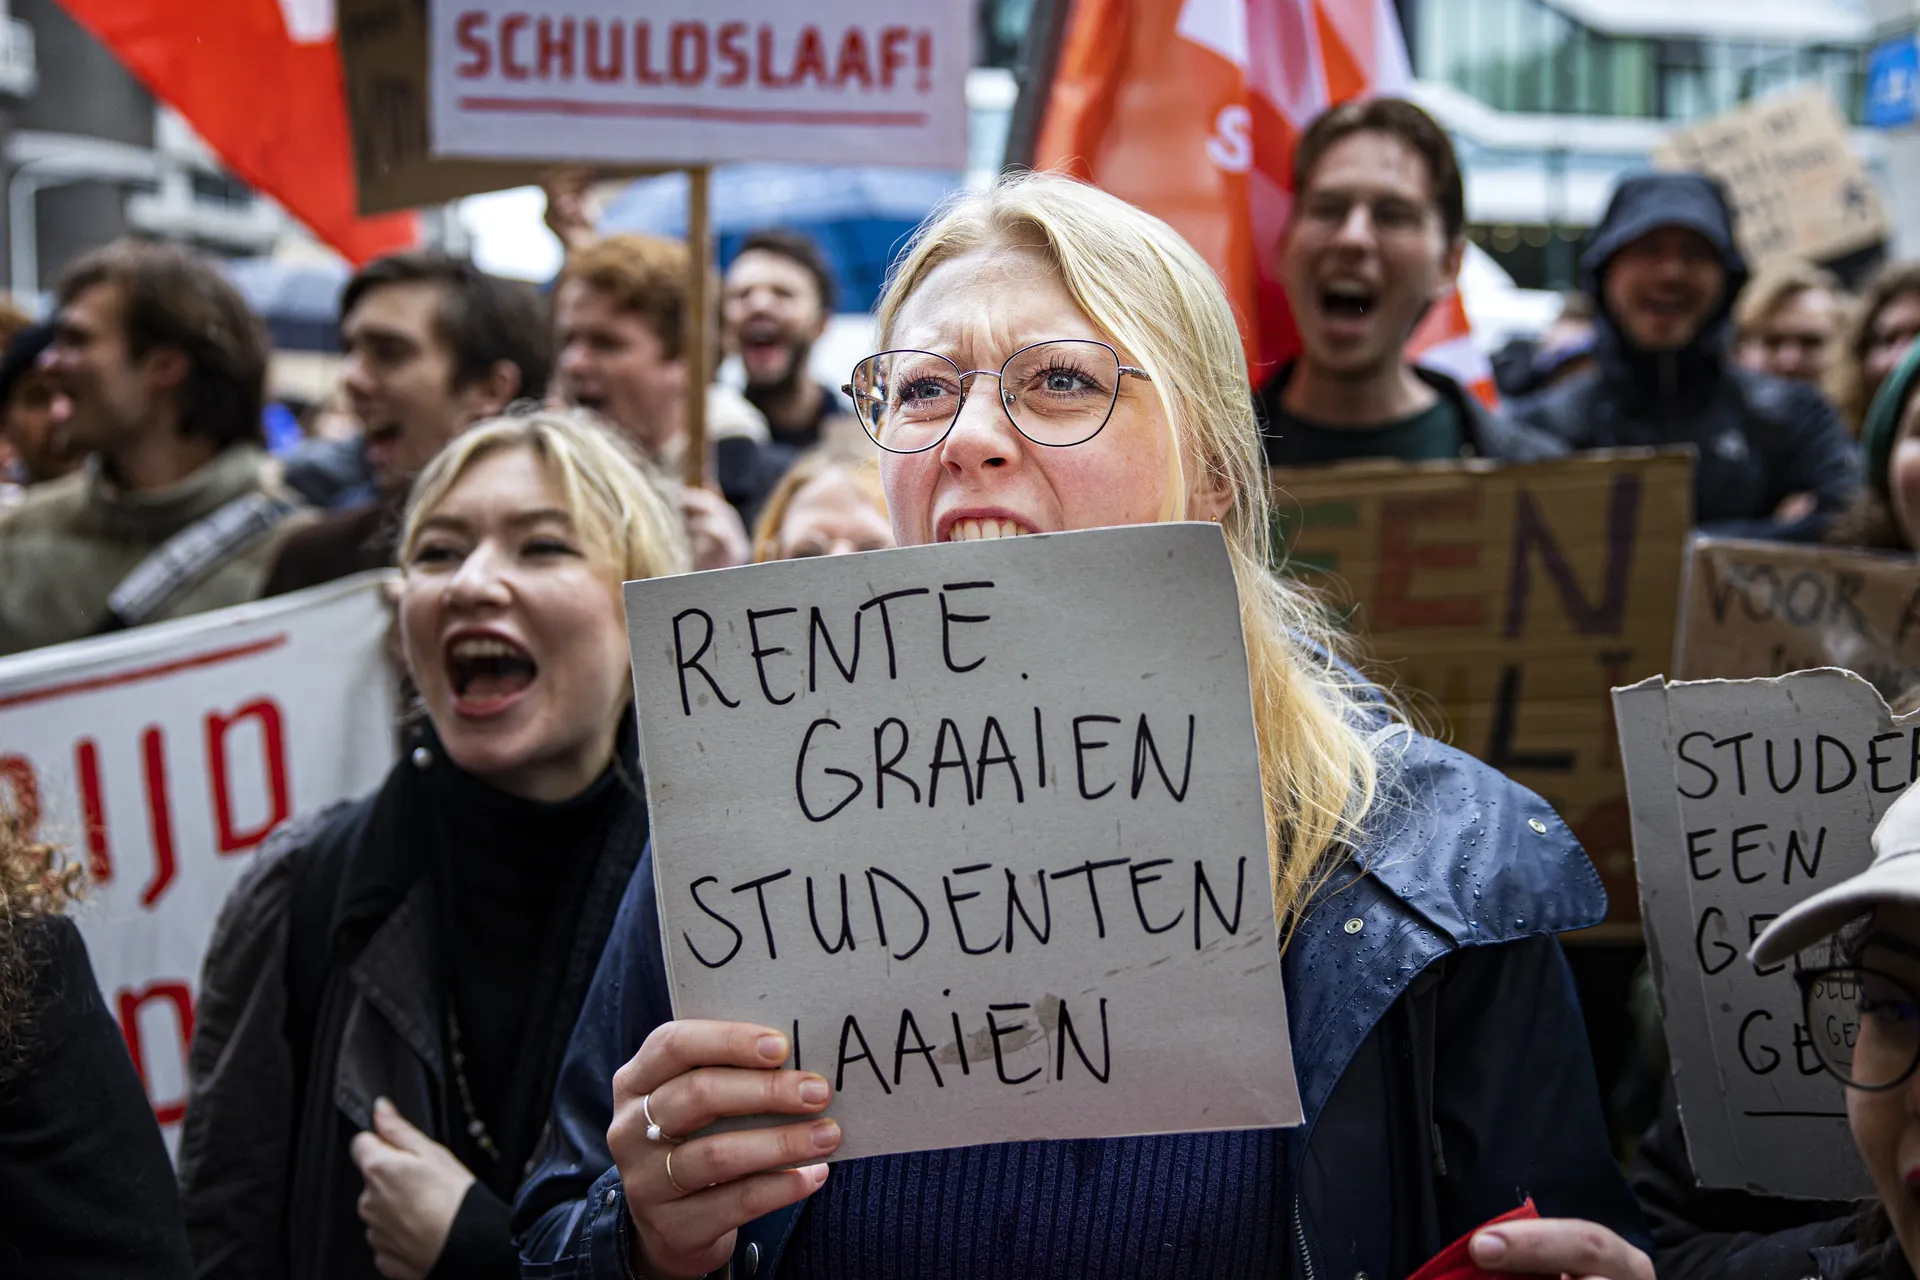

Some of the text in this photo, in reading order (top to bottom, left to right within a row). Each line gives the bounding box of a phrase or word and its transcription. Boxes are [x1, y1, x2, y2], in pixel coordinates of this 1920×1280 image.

[1701, 554, 1877, 642] VOOR
[795, 706, 1196, 823] GRAAIEN
[1687, 824, 1826, 885] EEN
[682, 856, 1248, 969] STUDENTEN
[1696, 906, 1786, 977] GE
[1738, 1009, 1825, 1076] GE
